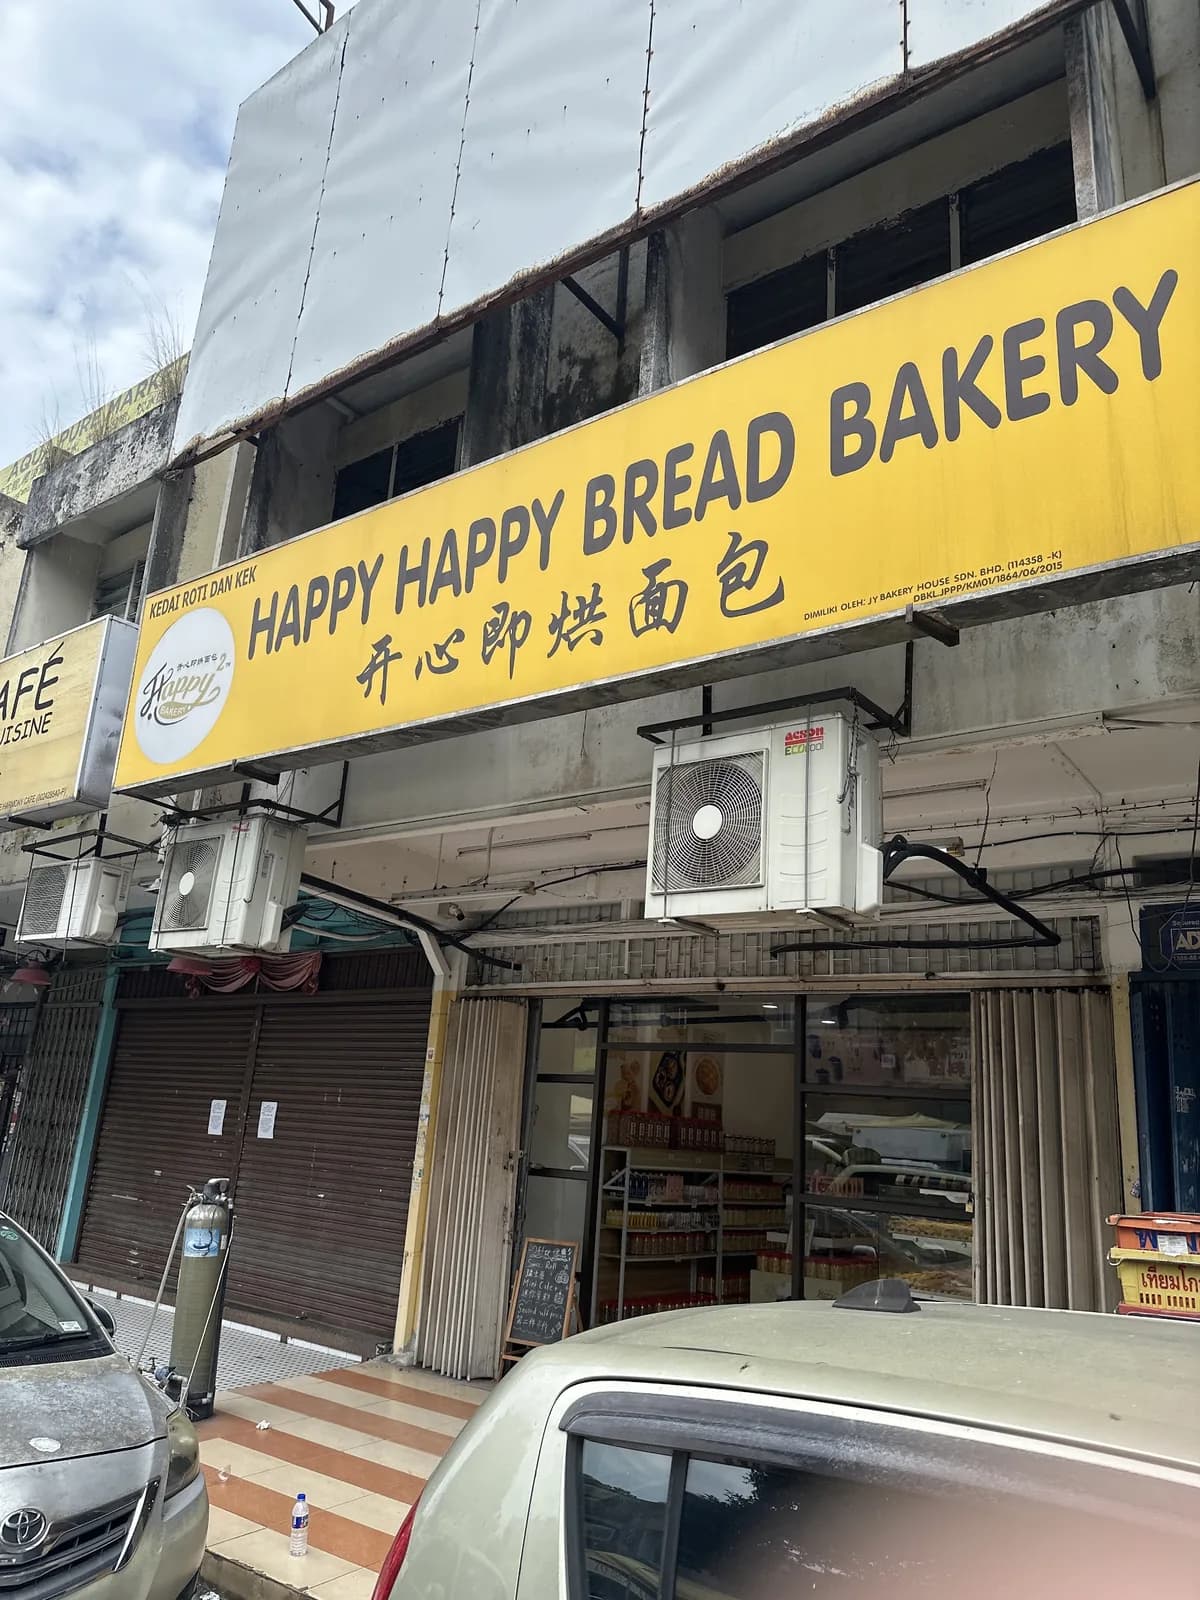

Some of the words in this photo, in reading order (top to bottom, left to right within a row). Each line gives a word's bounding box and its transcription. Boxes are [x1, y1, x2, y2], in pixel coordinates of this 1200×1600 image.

[248, 554, 383, 660] HAPPY
[395, 489, 564, 614] HAPPY
[583, 412, 795, 555] BREAD
[830, 270, 1178, 476] BAKERY
[149, 594, 181, 619] KEDAI
[182, 584, 209, 608] ROTI
[210, 574, 234, 597] DAN
[235, 565, 257, 588] KEK
[803, 606, 838, 621] DIMILIKI
[840, 599, 866, 612] OLEH:
[880, 585, 914, 601] BAKERY
[917, 576, 951, 592] HOUSE
[953, 570, 978, 583] SDN.
[980, 564, 1005, 578] BHD.
[1007, 554, 1044, 571] (114358
[356, 532, 784, 705] 开心即烘面包
[141, 662, 218, 712] Happy
[160, 705, 187, 717] BAKERY
